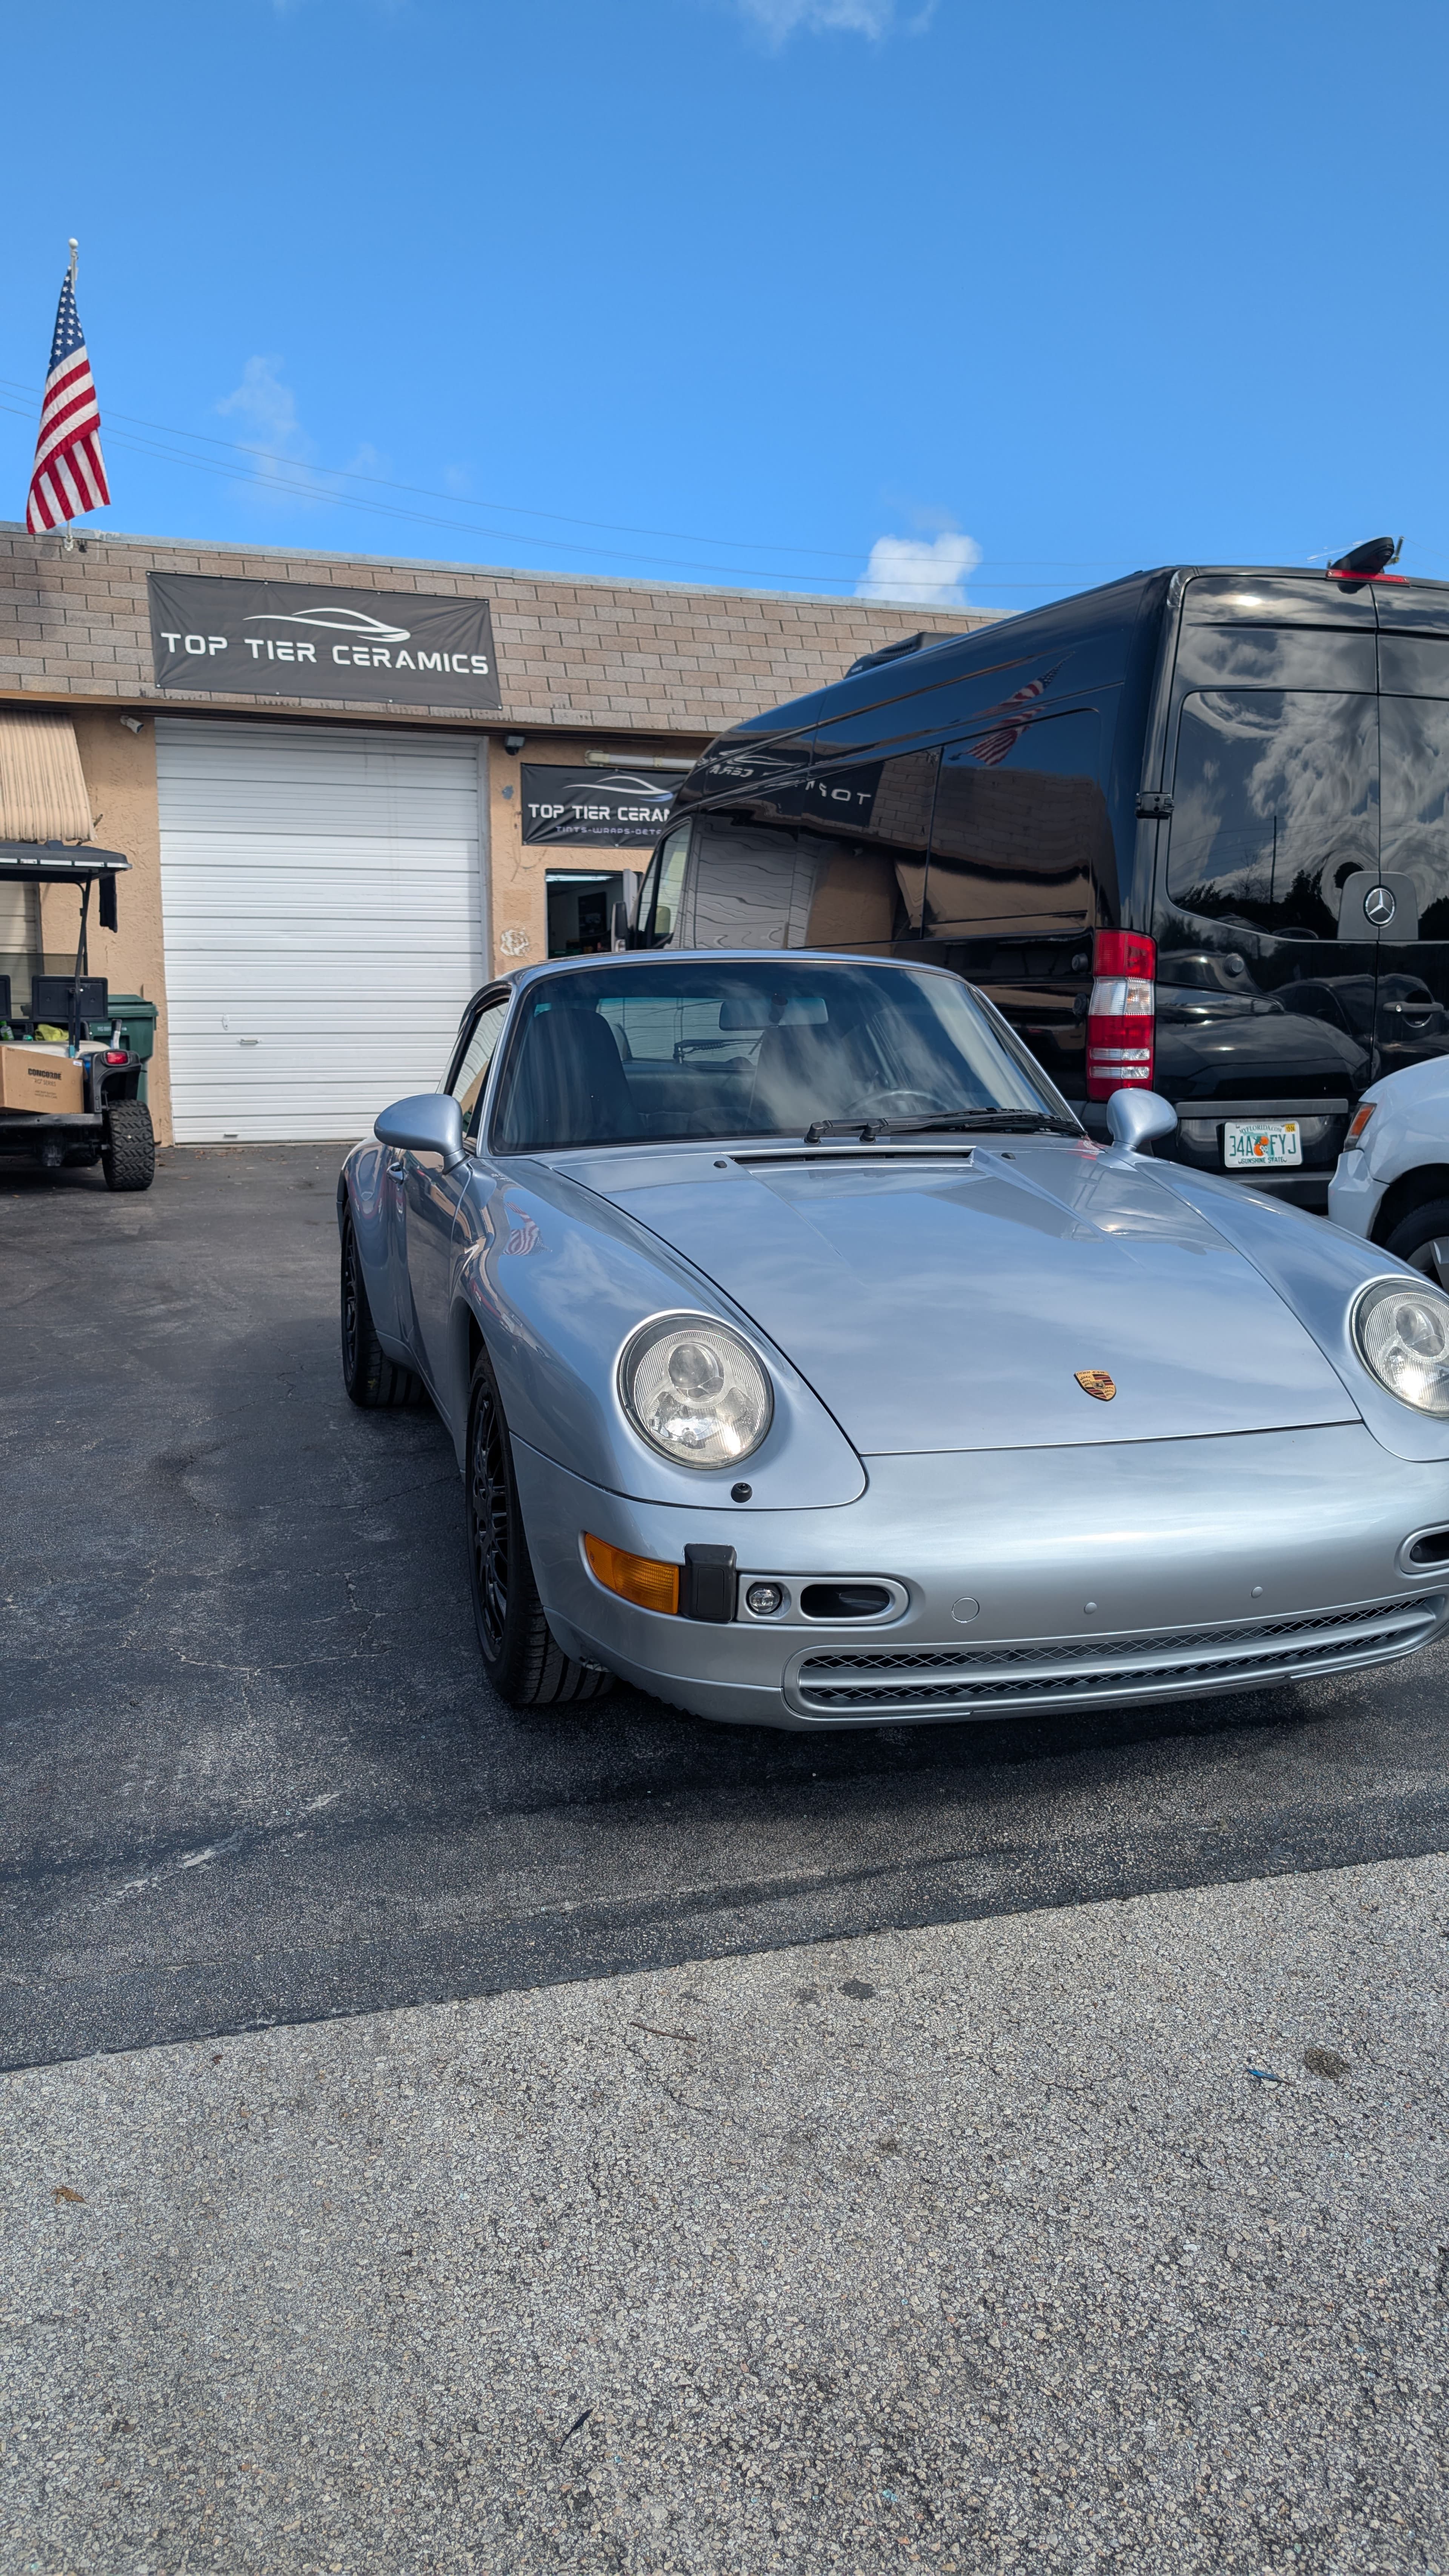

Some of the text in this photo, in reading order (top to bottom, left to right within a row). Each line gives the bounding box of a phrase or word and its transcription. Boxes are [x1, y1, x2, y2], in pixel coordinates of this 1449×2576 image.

[160, 632, 489, 675] TOP TIER CERAMICS
[528, 804, 565, 818] TOP
[571, 806, 611, 820] TIER
[28, 1068, 62, 1080] CONCORDE
[1239, 1125, 1282, 1133] MYFLORIDA.COM
[1270, 1133, 1296, 1155] FYJ
